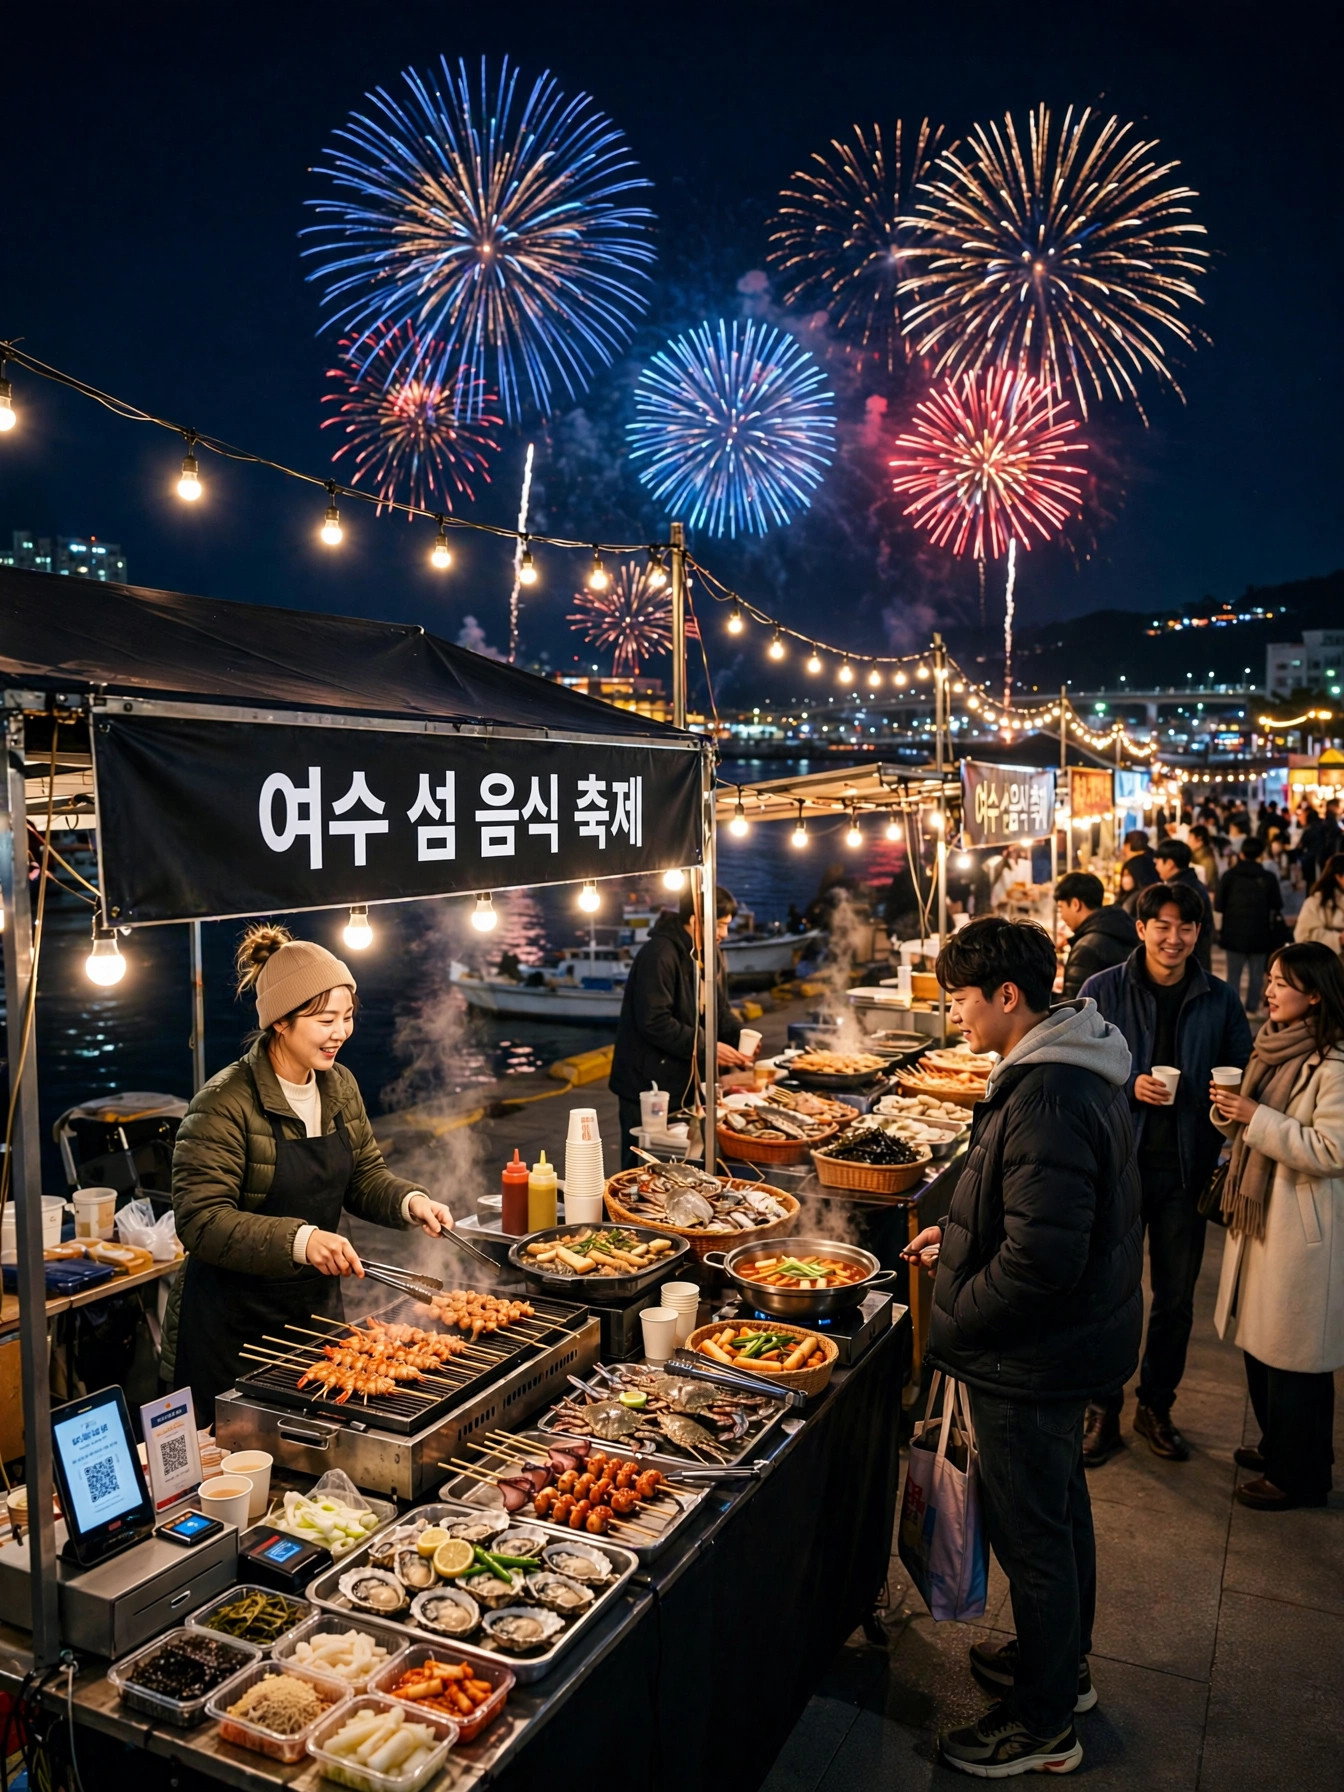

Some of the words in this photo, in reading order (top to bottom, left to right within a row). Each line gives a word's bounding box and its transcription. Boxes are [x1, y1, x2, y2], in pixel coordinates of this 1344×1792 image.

[258, 766, 389, 869] 여수
[406, 770, 456, 862] 섬
[475, 772, 559, 858] 음식
[574, 773, 643, 850] 축제
[975, 780, 1000, 835] 여수
